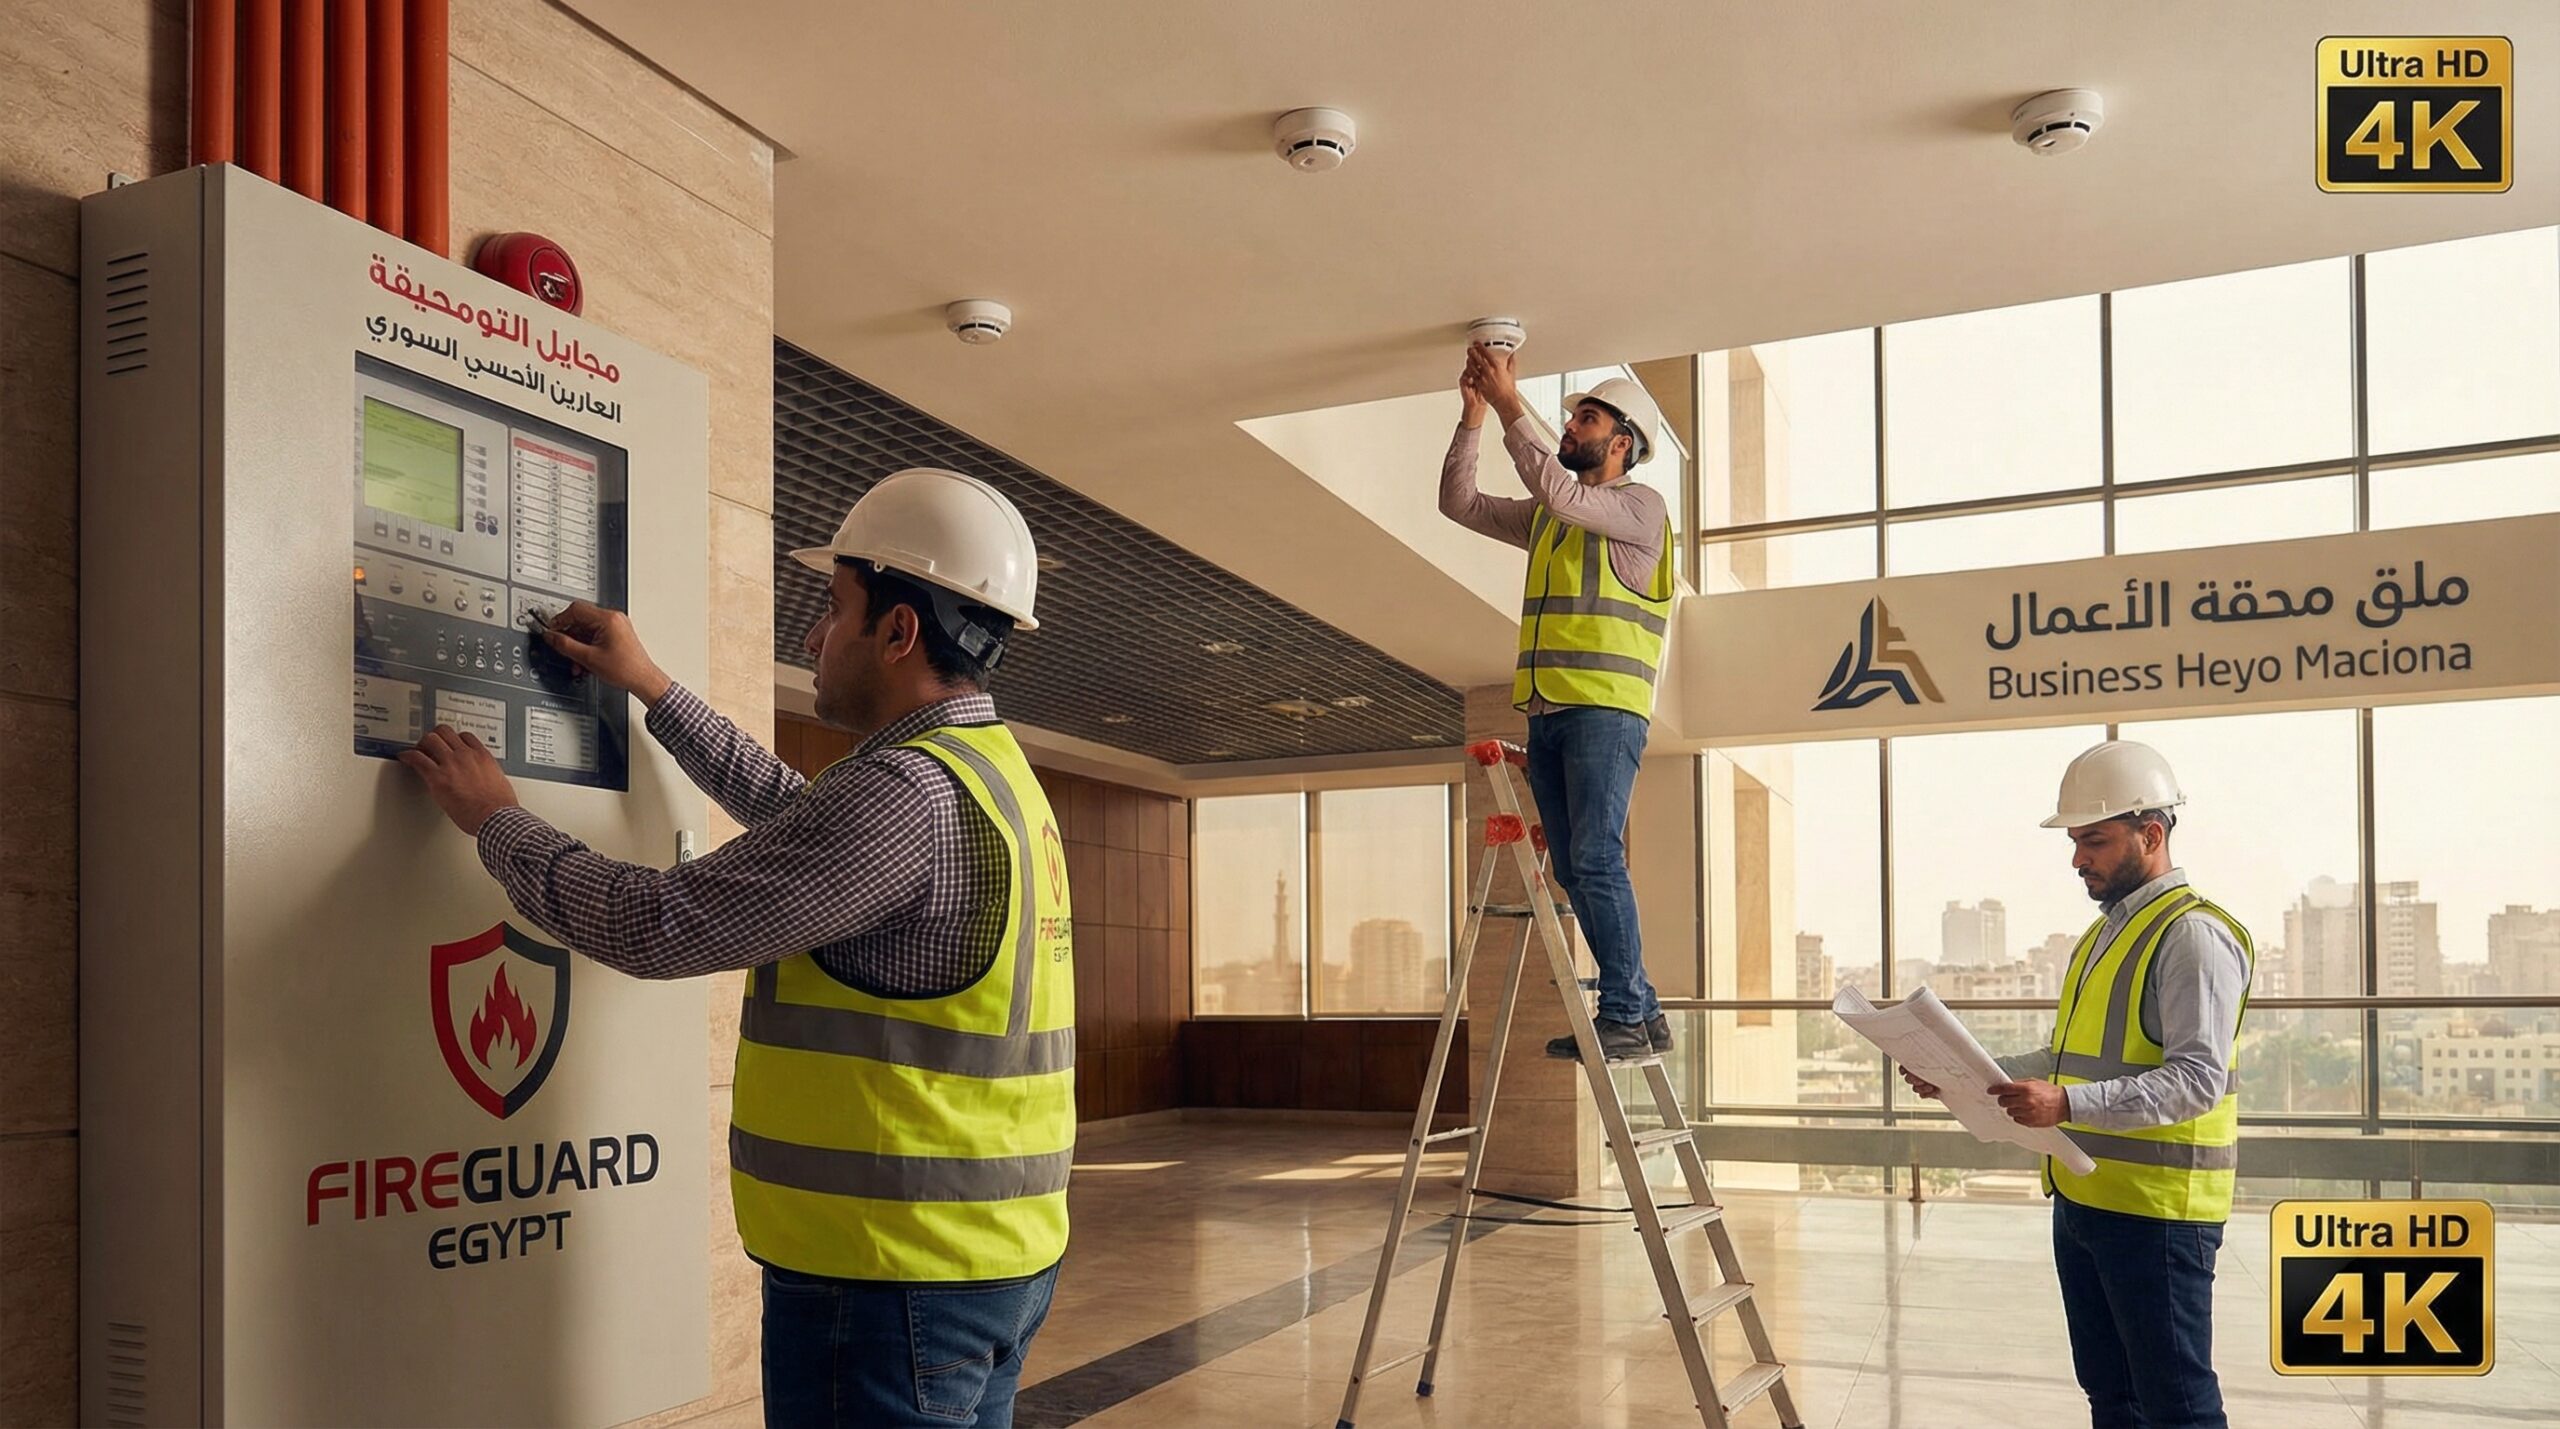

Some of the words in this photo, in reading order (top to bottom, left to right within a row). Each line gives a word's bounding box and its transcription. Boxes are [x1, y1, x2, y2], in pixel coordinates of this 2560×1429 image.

[366, 315, 458, 361] السوري
[1985, 578, 2170, 651] الأعمال
[2190, 579, 2334, 623] محقة
[2355, 560, 2470, 628] ملق
[1988, 660, 2163, 700] Business
[2177, 652, 2282, 694] Heyo
[2295, 638, 2473, 682] Maciona
[307, 1133, 660, 1227] FIREGUARD
[428, 1211, 572, 1271] EGYPT
